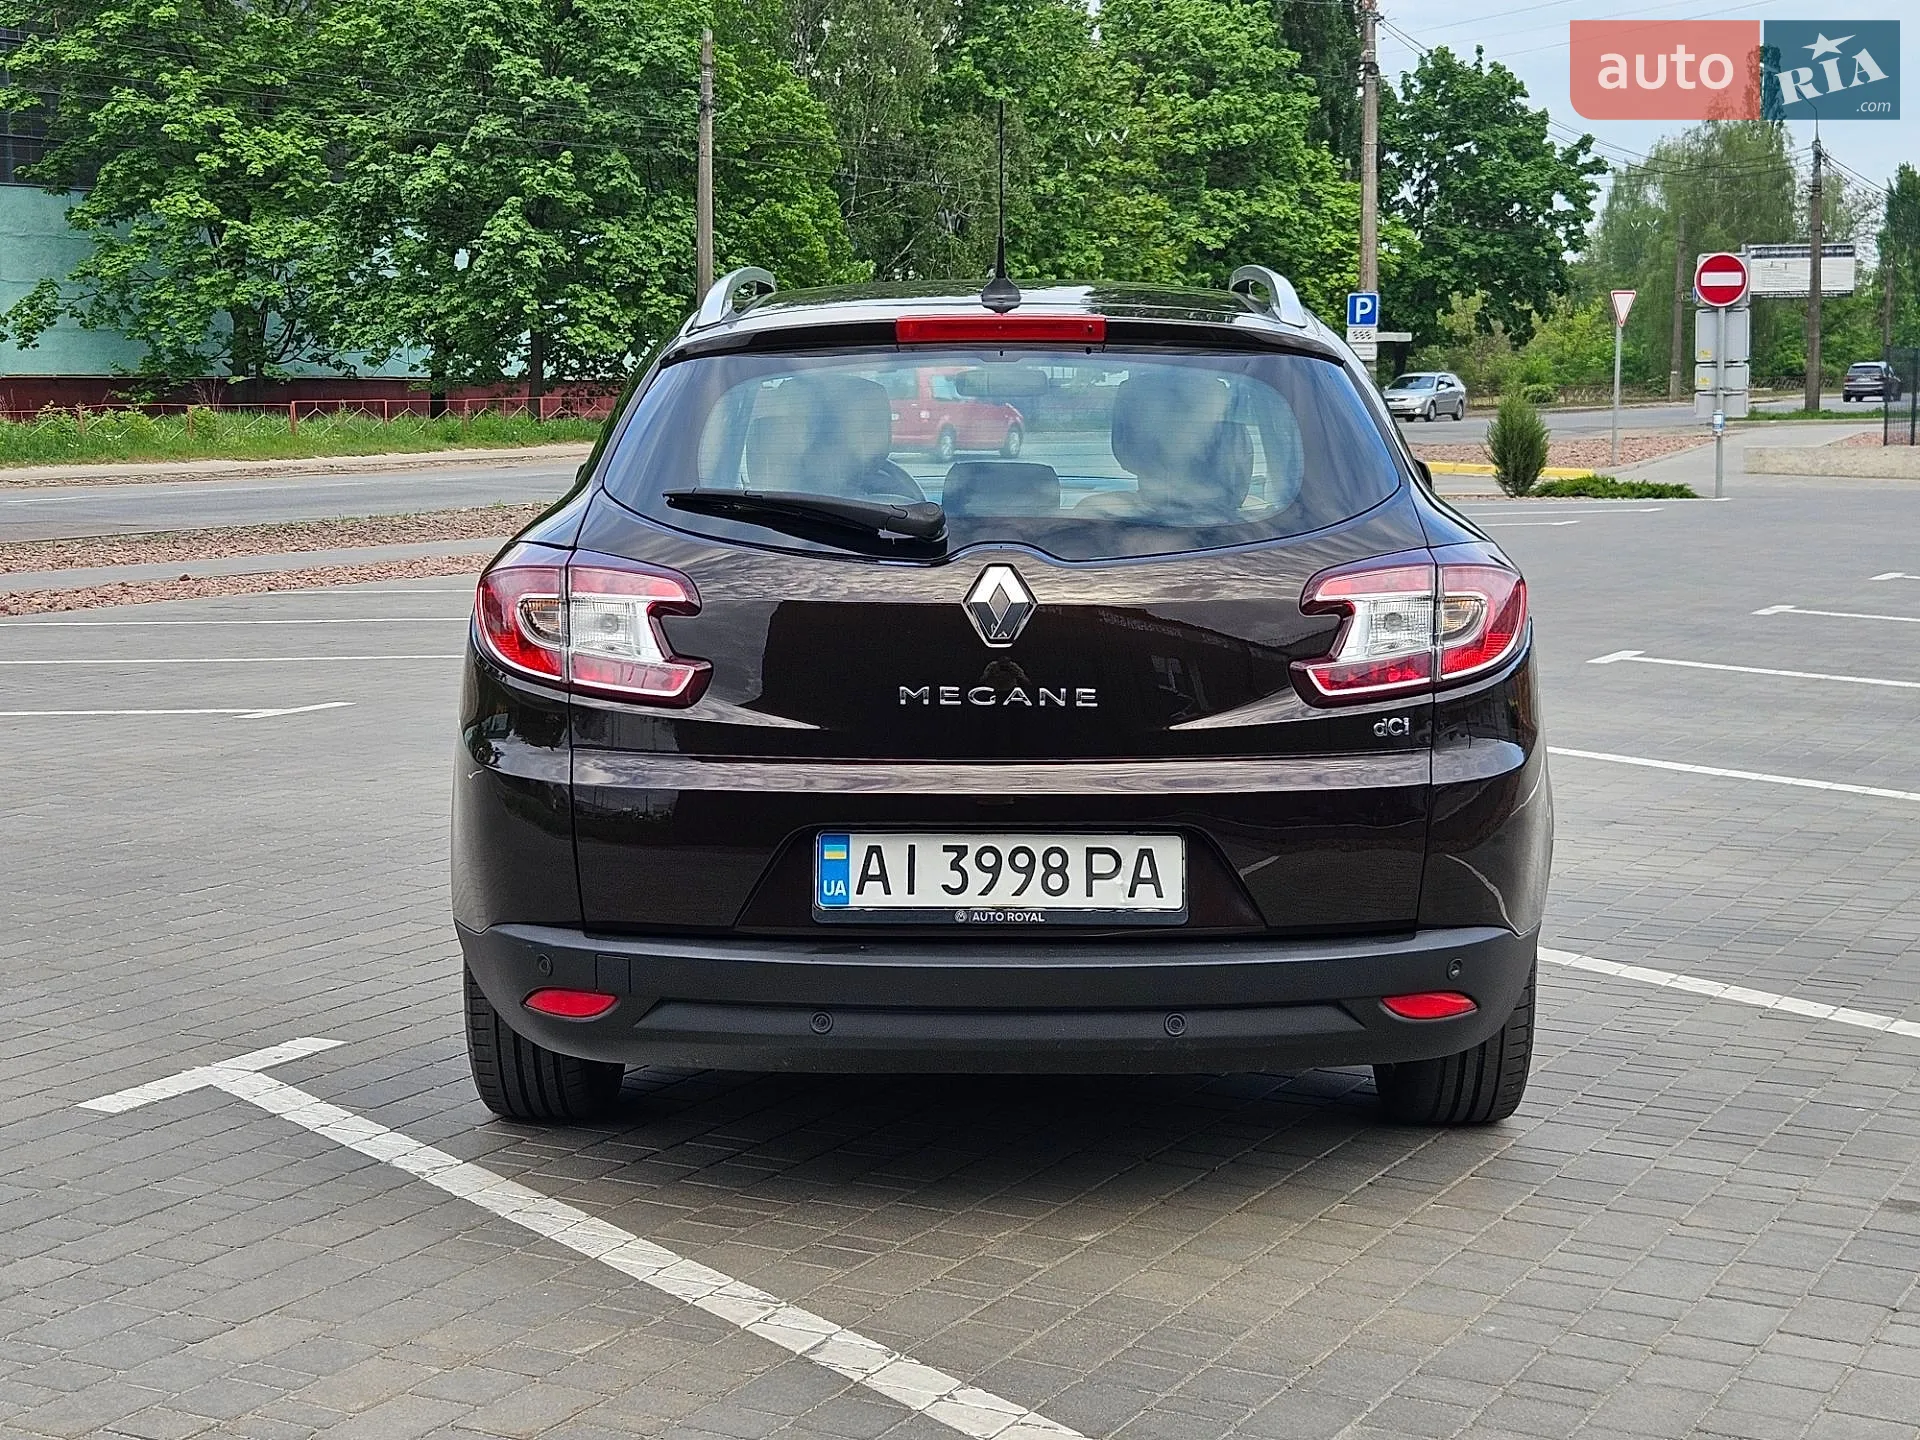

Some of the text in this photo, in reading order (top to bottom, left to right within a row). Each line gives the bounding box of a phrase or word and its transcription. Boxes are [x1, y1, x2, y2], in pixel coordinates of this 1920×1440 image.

[1355, 297, 1373, 324] P
[899, 686, 1098, 707] MEGANE
[855, 844, 1164, 899] AI 3998 PA
[823, 880, 847, 897] UA
[972, 911, 1046, 922] AUTO ROYAL
